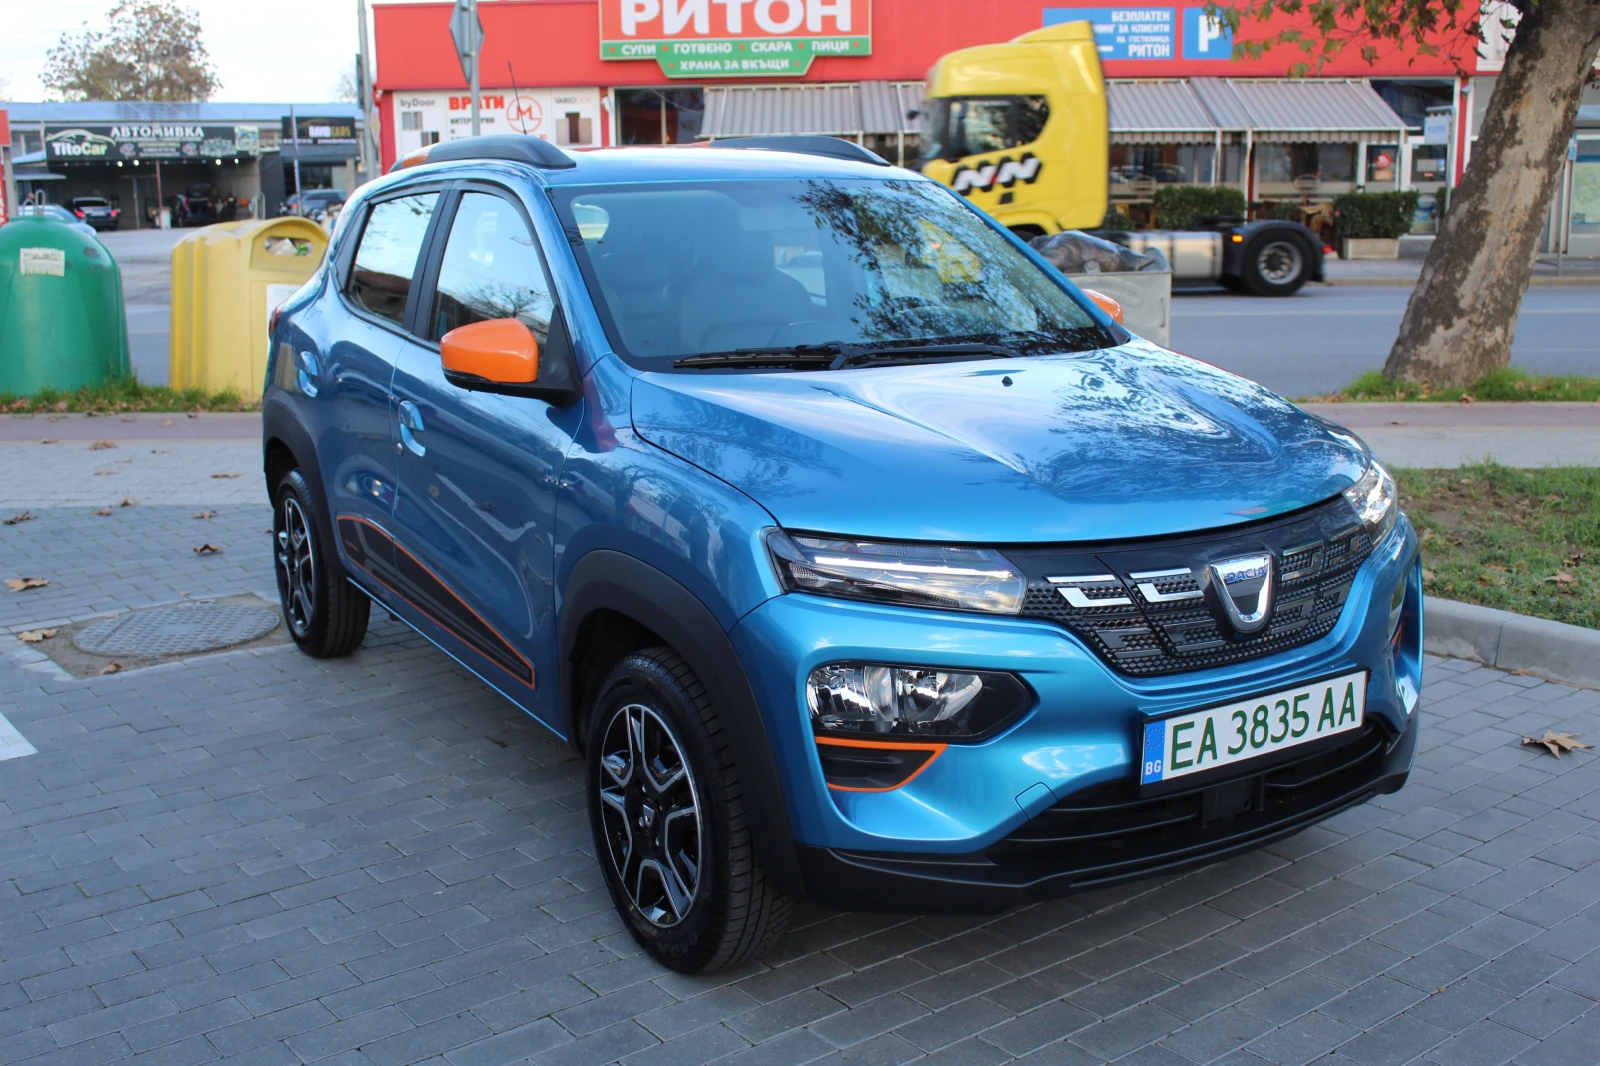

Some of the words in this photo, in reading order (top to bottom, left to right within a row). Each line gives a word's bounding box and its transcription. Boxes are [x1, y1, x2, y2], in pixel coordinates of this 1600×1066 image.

[621, 0, 852, 36] РИТОН
[1111, 10, 1170, 22] БЕЗПЛАТЕН
[1118, 24, 1129, 34] ЗА
[1131, 23, 1170, 34] КЛИЕНТИ
[621, 44, 656, 56] СУПИ
[674, 42, 733, 54] ГОТВЕНО
[751, 41, 793, 53] СКАРА
[812, 40, 849, 52] ПИЦИ
[1128, 44, 1170, 57] РИТОН
[680, 59, 721, 71] ХРАНА
[724, 59, 738, 70] ЗА
[742, 58, 789, 70] ВКЪЩИ
[400, 98, 435, 108] byDoor
[448, 95, 505, 110] ВРТИ
[110, 126, 205, 138] АВТОМИВКА
[51, 141, 108, 156] TitoCar
[1226, 567, 1267, 584] DACIA
[1170, 716, 1218, 772] EA
[1227, 692, 1310, 755] 3835
[1316, 681, 1357, 733] AA
[1145, 760, 1162, 776] BG
